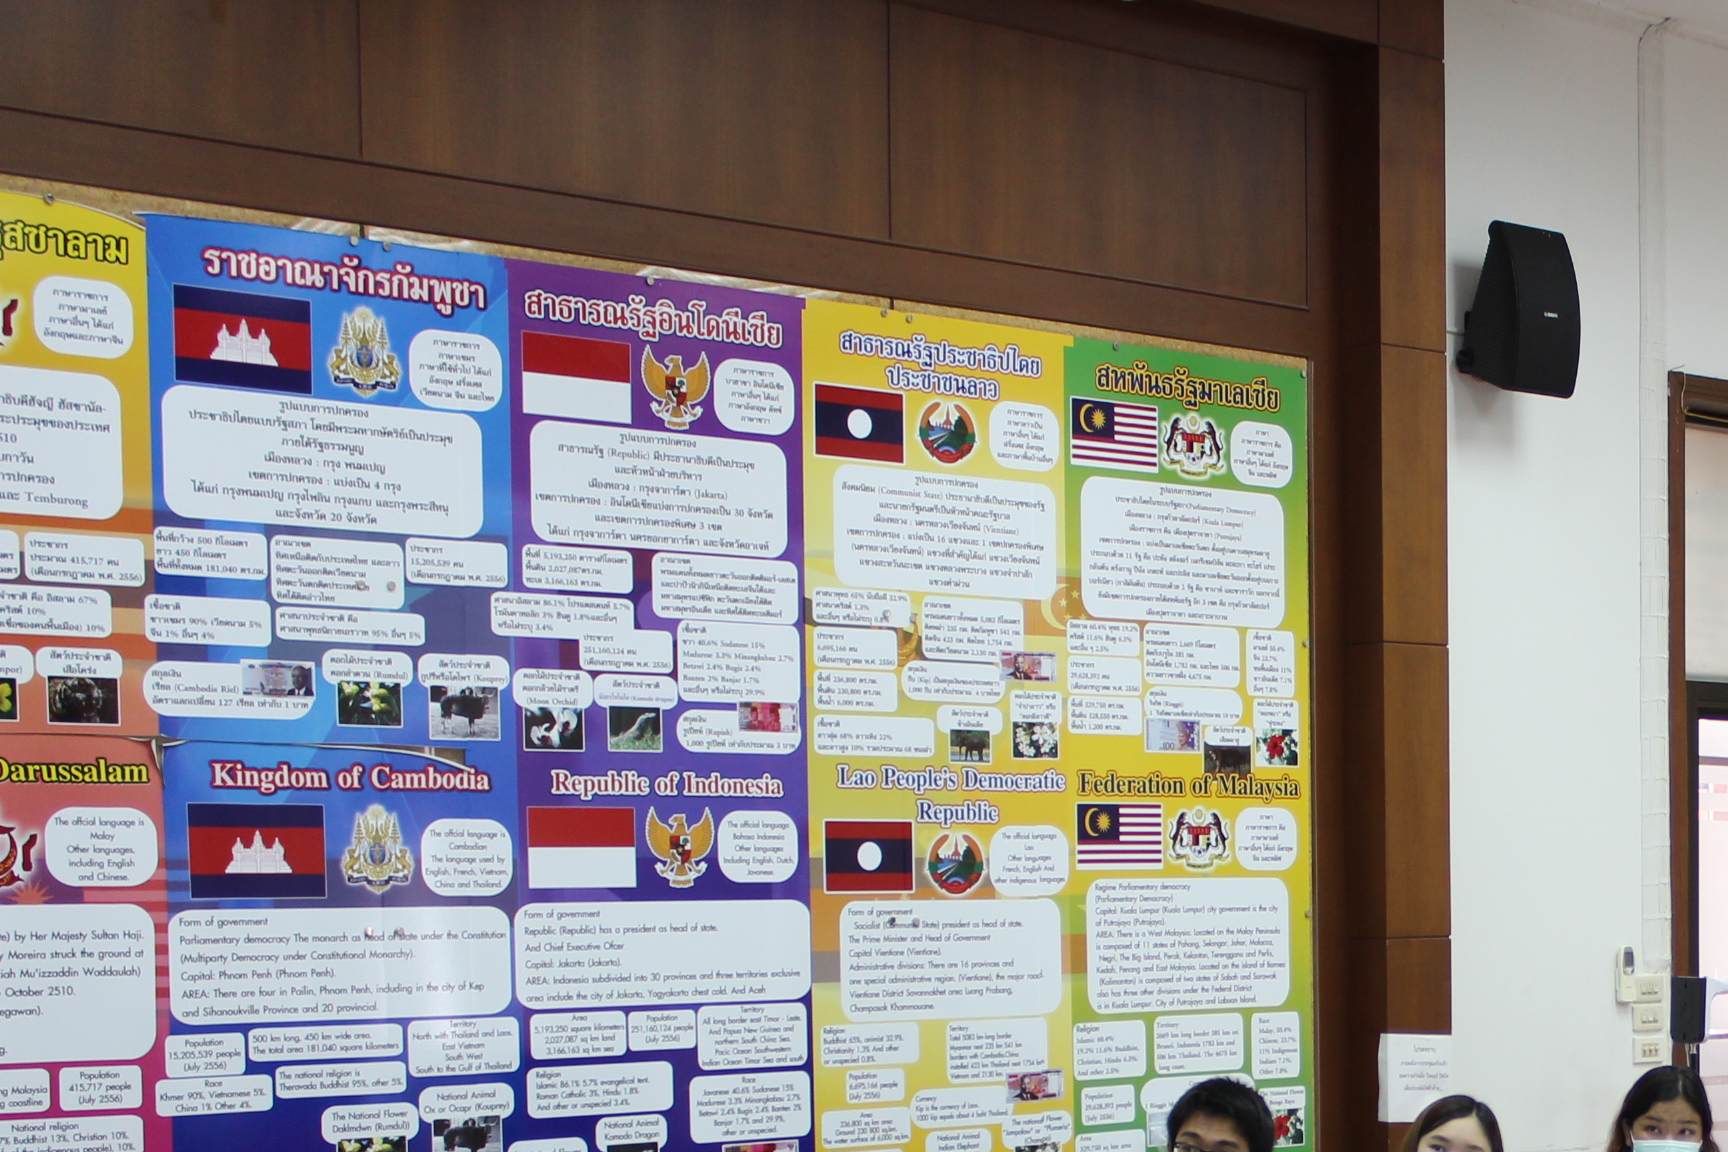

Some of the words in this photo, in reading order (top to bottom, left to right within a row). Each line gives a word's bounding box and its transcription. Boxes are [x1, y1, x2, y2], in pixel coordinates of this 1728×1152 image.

[203, 246, 487, 317] ราชอาณาจักรกัมพูชา
[525, 289, 783, 348] สาธารณรัฐอินโดนีเซีย
[840, 329, 1042, 378] สาธารณรัฐประชาธิปไตย
[886, 364, 1000, 400] ประชาชนลาว
[1096, 360, 1280, 412] สหพันธรัฐมาเลเซีย
[330, 512, 342, 522] 20
[211, 760, 330, 794] Kingdom
[337, 763, 363, 791] of
[371, 764, 492, 793] Cambodia
[551, 769, 651, 801] Republic
[654, 771, 680, 796] of
[684, 772, 784, 798] Indonesia
[836, 763, 878, 789] Lao
[880, 765, 958, 794] People's
[962, 768, 1067, 793] Democratic
[1077, 770, 1187, 797] Federation
[1190, 771, 1213, 797] of
[1216, 773, 1301, 803] Malaysia
[916, 799, 1000, 828] Republic
[90, 830, 115, 842] Malay
[178, 917, 201, 927] Form
[204, 915, 213, 927] of
[216, 918, 267, 929] government
[524, 909, 543, 919] Form
[546, 908, 554, 918] of
[556, 910, 600, 921] government
[14, 930, 26, 943] by
[30, 931, 47, 941] Her
[51, 930, 87, 943] Majesty
[91, 928, 119, 940] Sultan
[123, 929, 145, 942] Haji.
[524, 925, 556, 937] Republic
[559, 924, 596, 937] (Republic)
[599, 923, 612, 934] has
[622, 923, 656, 935] president
[669, 922, 687, 932] head
[690, 921, 697, 932] of
[700, 924, 718, 932] state.
[179, 933, 240, 947] Parliamentary
[243, 932, 290, 946] democracy
[293, 931, 308, 943] The
[312, 931, 348, 942] monarch
[351, 934, 360, 942] as
[421, 931, 443, 941] under
[447, 931, 458, 940] the
[461, 930, 506, 940] Constitution
[524, 942, 540, 952] And
[543, 941, 564, 952] Chief
[566, 941, 600, 951] Executive
[603, 940, 624, 950] Ofcer
[848, 934, 860, 944] The
[862, 934, 880, 943] Prime
[883, 934, 907, 942] Minister
[910, 933, 922, 942] and
[925, 933, 942, 942] Head
[944, 932, 950, 942] of
[952, 932, 990, 941] Government
[7, 949, 45, 959] Moreira
[50, 947, 76, 958] struck
[80, 947, 94, 958] the
[97, 947, 131, 961] ground
[134, 949, 143, 957] at
[180, 952, 228, 965] (Multiparty
[231, 951, 279, 964] Democracy
[282, 950, 307, 961] under
[310, 949, 366, 960] Constitutional
[369, 947, 414, 961] Monarchy).
[874, 948, 904, 956] Vientiane
[907, 947, 942, 957] (Vientiane).
[525, 958, 554, 971] Capital:
[557, 957, 584, 968] Jakarta
[587, 957, 622, 968] (Jakarta).
[180, 969, 214, 983] Capital:
[218, 969, 248, 980] Phnom
[251, 968, 272, 979] Penh
[275, 967, 307, 979] (Phnom
[310, 966, 337, 978] Penh).
[4, 985, 43, 997] October
[47, 985, 76, 996] 2510.
[181, 1006, 199, 1017] and
[202, 1004, 259, 1016] Sihanoukville
[263, 1004, 298, 1014] Province
[301, 1002, 318, 1013] and
[321, 1002, 333, 1013] 20
[336, 1001, 378, 1014] provincial.
[184, 1037, 223, 1049] Population
[183, 1061, 200, 1073] (July
[203, 1061, 226, 1070] 2556)
